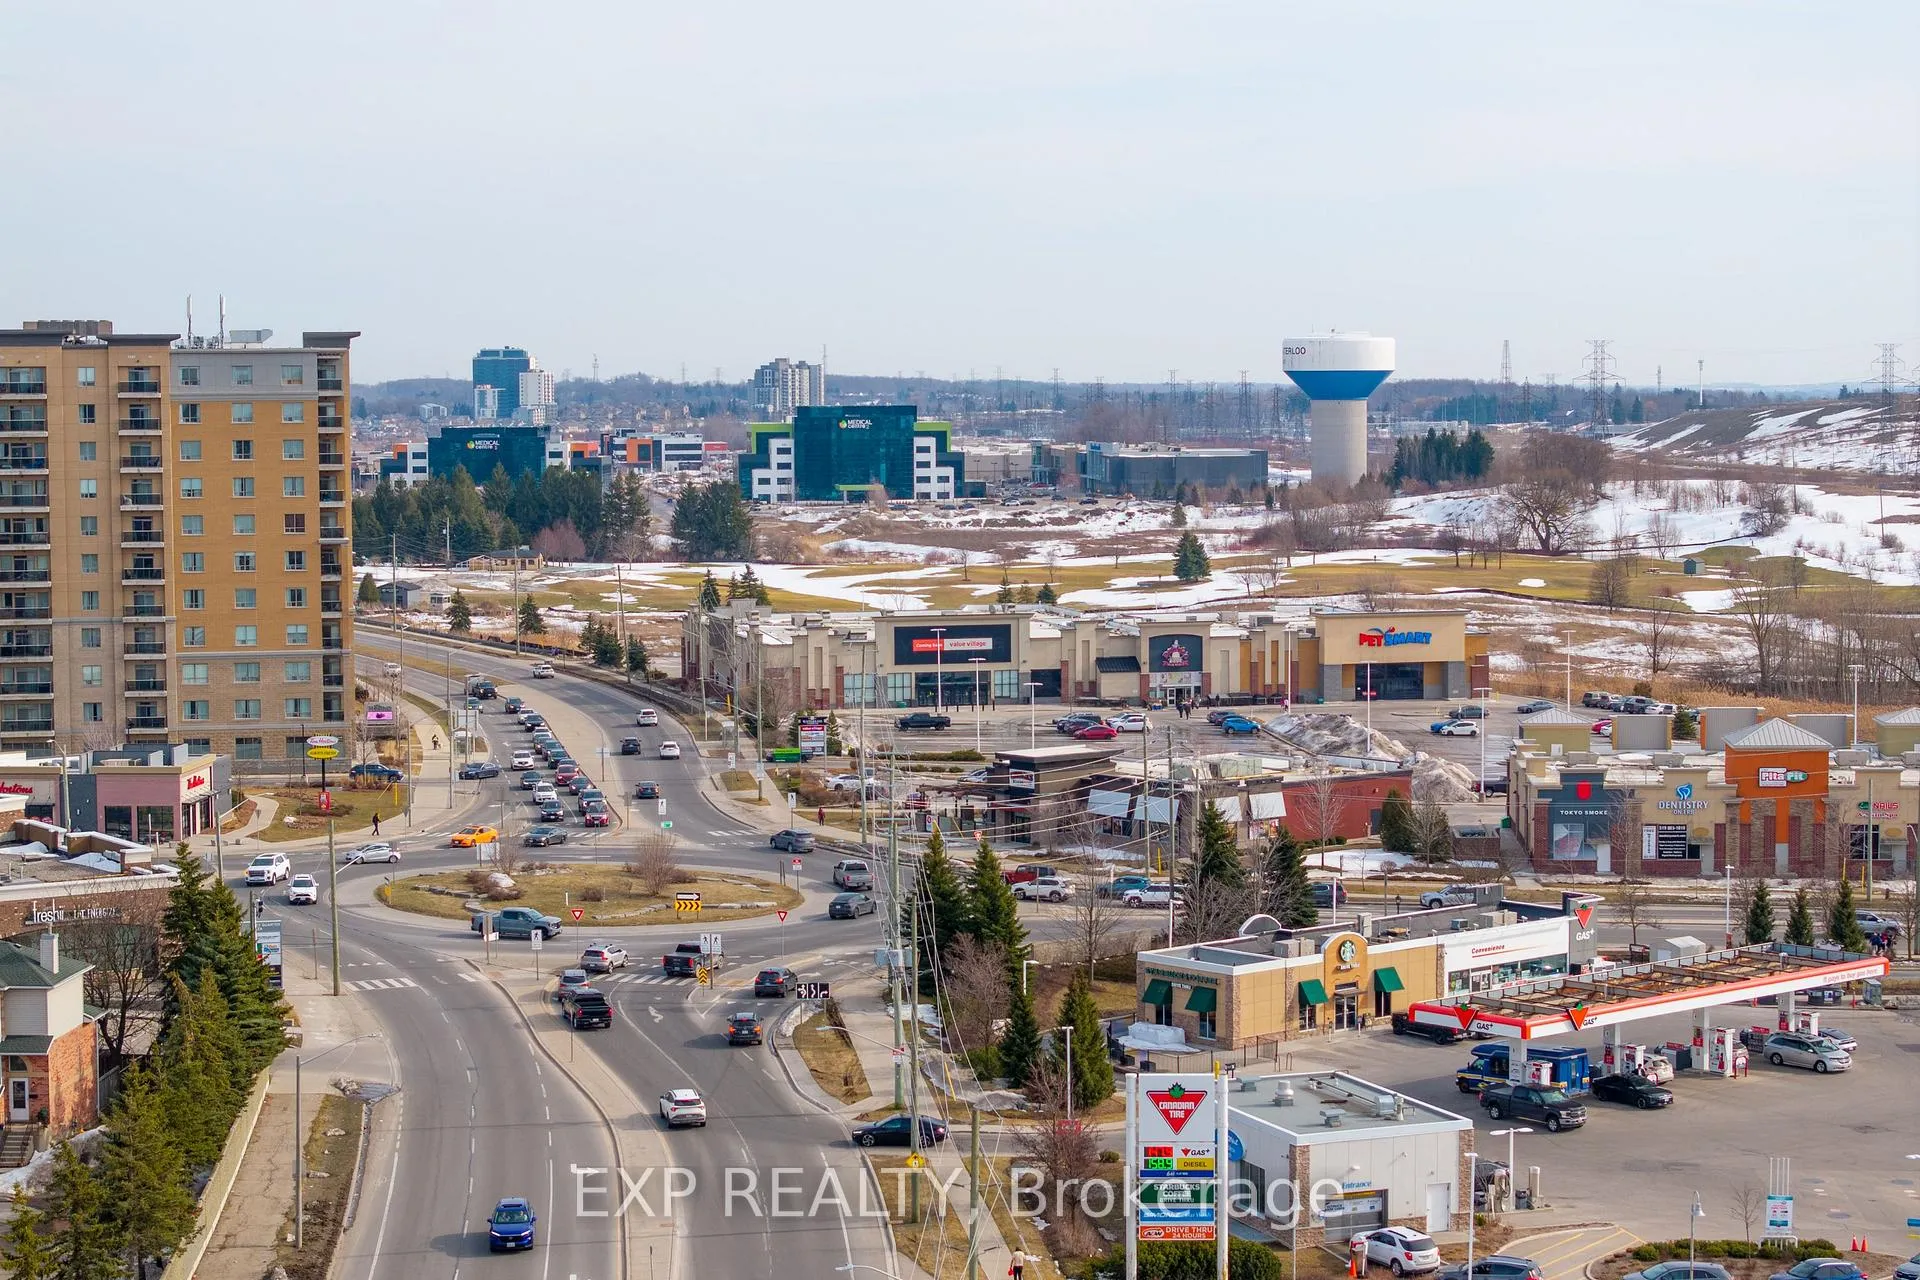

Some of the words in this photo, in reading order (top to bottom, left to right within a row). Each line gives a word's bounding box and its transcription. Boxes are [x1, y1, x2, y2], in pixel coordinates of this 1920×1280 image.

[1761, 772, 1785, 781] Pita
[1658, 801, 1708, 809] DENTISTRY
[32, 898, 64, 923] freshii
[1471, 944, 1505, 955] Convenience
[1159, 1101, 1195, 1110] CANADIAN
[1169, 1110, 1185, 1118] TIRE
[1153, 1183, 1201, 1191] STARBUCKS
[1341, 1181, 1372, 1190] Entrance
